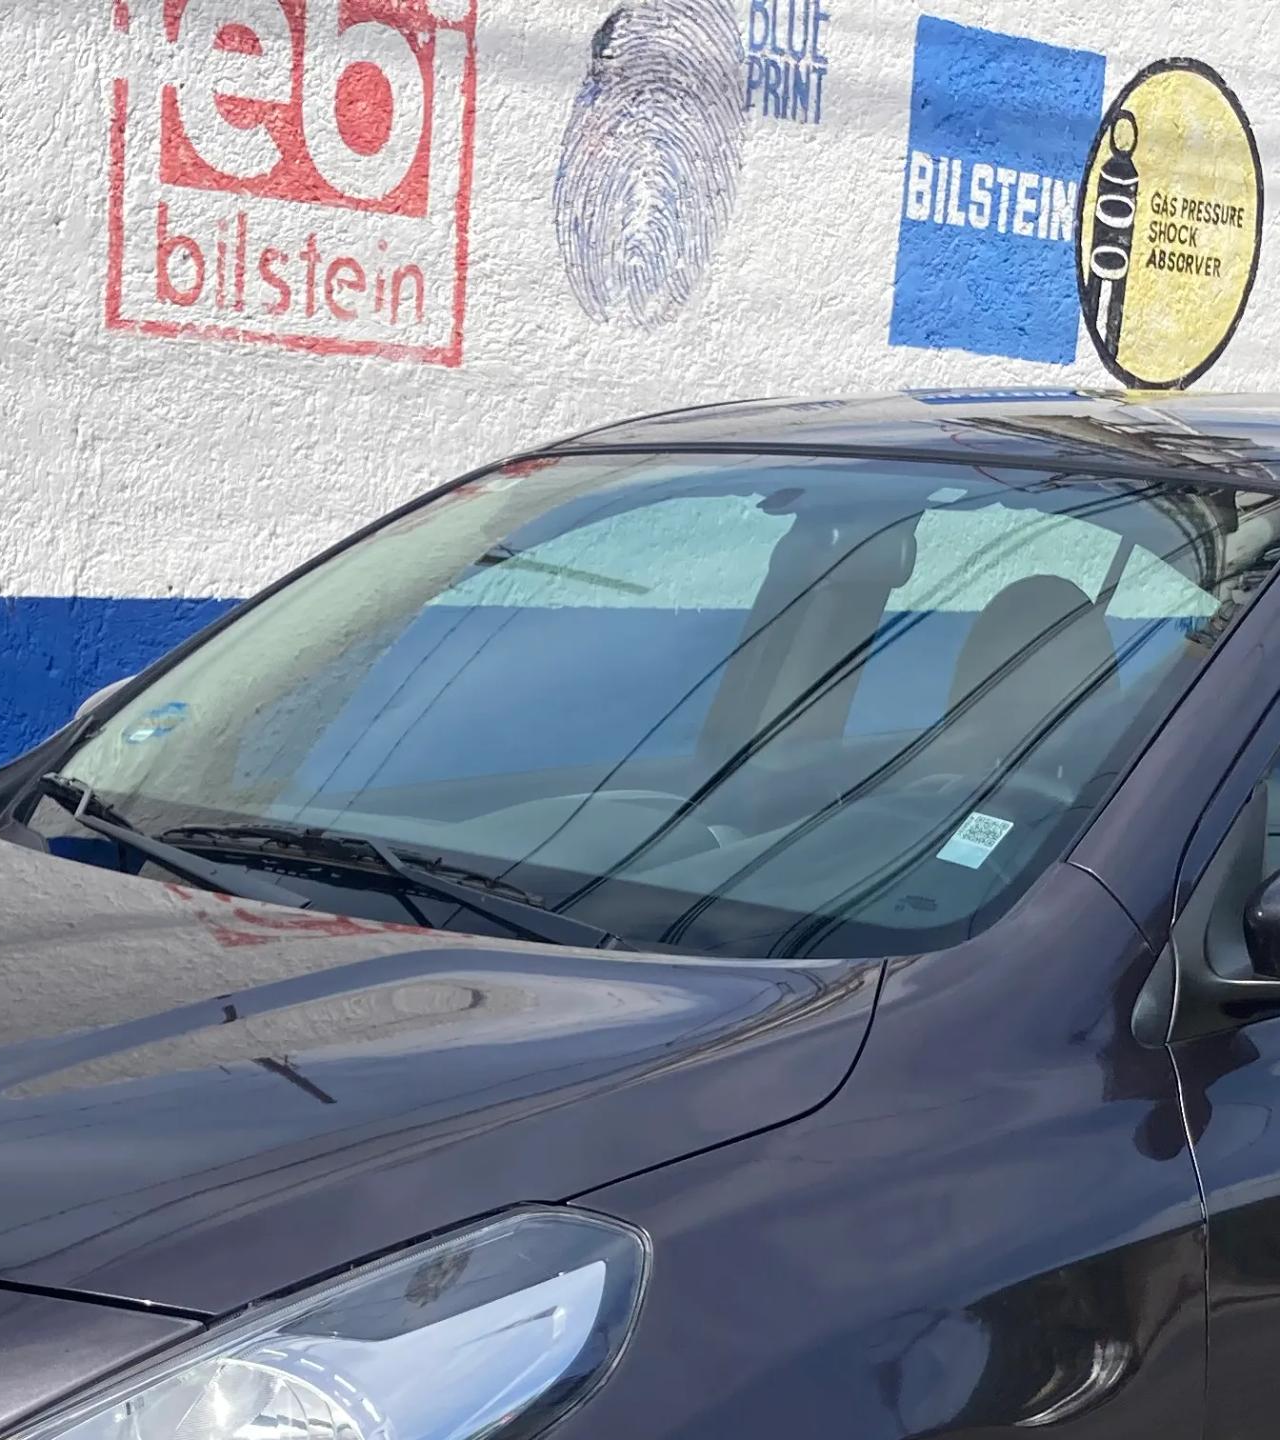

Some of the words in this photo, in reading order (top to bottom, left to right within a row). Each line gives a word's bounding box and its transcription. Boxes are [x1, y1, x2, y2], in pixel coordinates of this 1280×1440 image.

[748, 0, 831, 64] BLUE
[743, 54, 828, 125] PRINT
[906, 149, 1078, 242] BILSTEIN
[1150, 191, 1178, 218] GAS
[1180, 197, 1245, 229] PRESSURE
[155, 200, 425, 326] bilstein
[1146, 249, 1221, 277] ABSORVER
[1148, 221, 1198, 247] SHOCK
